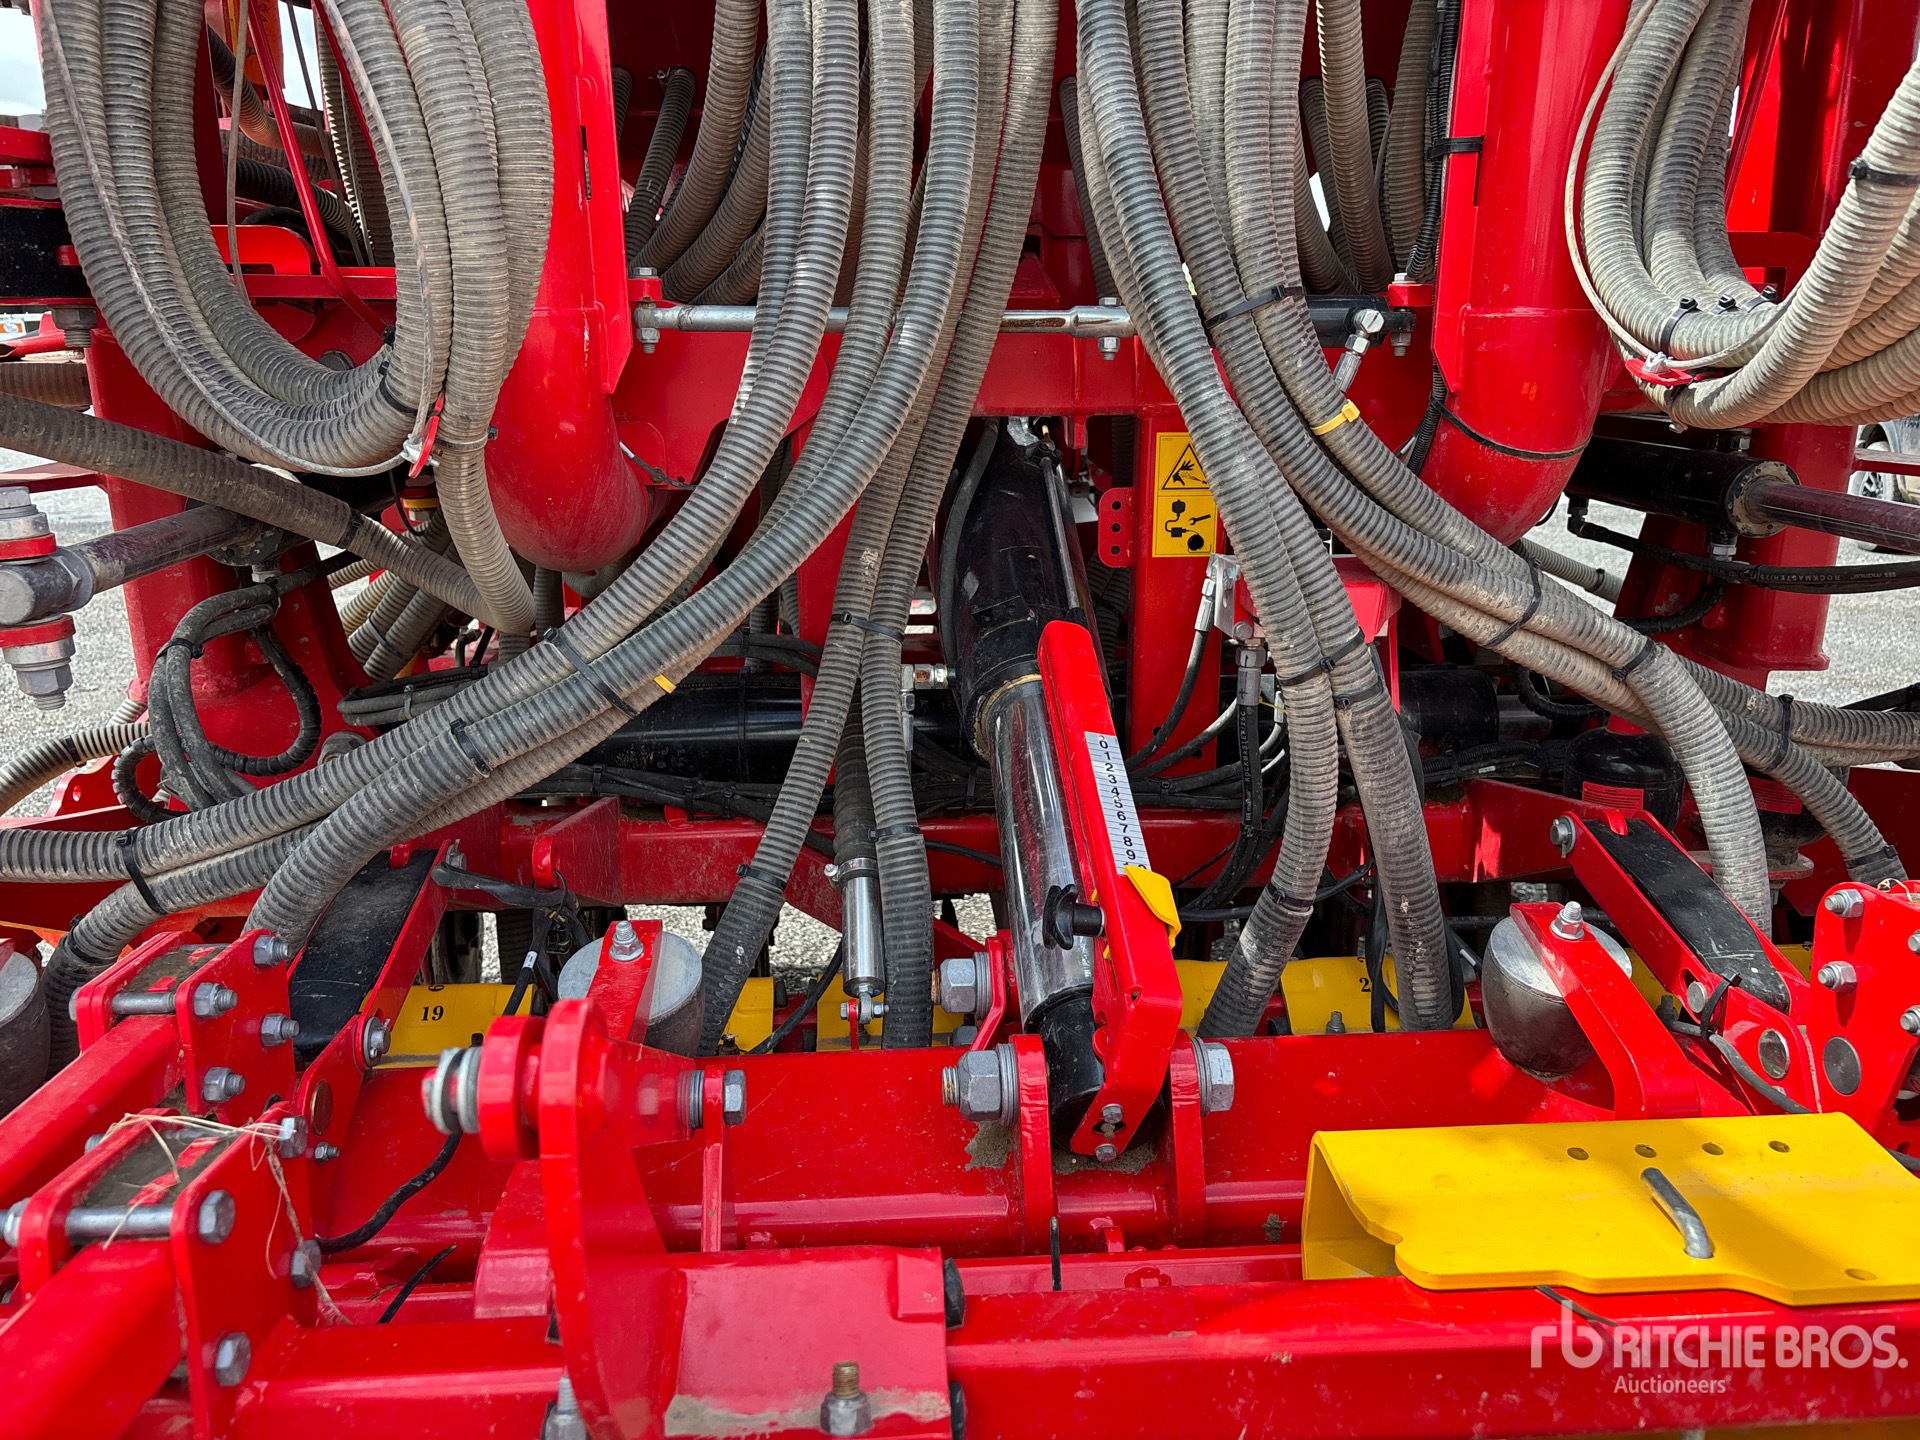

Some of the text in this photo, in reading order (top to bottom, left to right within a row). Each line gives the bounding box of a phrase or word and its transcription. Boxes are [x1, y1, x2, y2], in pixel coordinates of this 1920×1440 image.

[1099, 740, 1109, 750] 0
[1103, 752, 1111, 761] 1
[1104, 763, 1115, 773] 2
[1108, 775, 1117, 785] 3
[1111, 786, 1120, 797] 4
[1114, 799, 1123, 809] 5
[1117, 810, 1126, 821] 6
[1120, 823, 1128, 833] 7
[1123, 836, 1133, 847] 8
[1126, 849, 1136, 860] 9
[421, 1005, 445, 1022] 19
